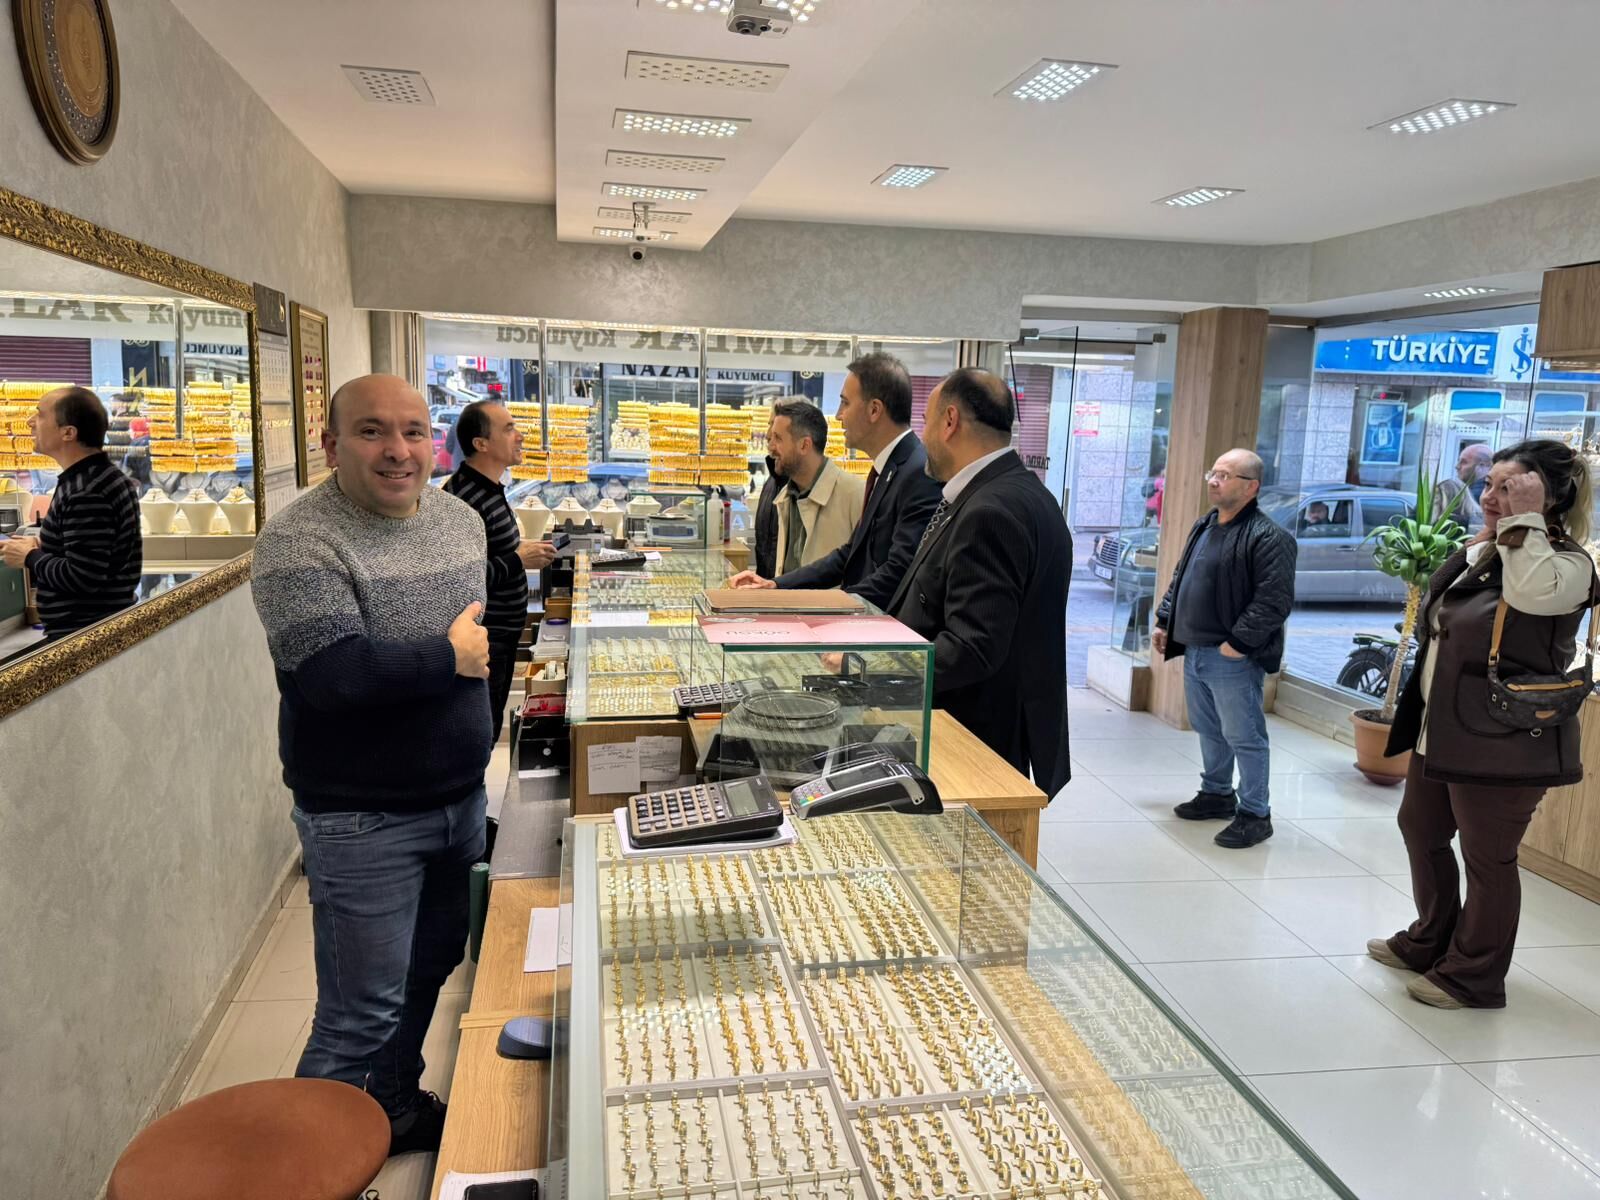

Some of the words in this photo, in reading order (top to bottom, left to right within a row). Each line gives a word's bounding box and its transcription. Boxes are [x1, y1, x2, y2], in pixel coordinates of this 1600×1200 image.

[147, 304, 248, 331] Kuyum
[1372, 334, 1491, 366] TÜRKİYE
[717, 370, 776, 382] KUYUMCU
